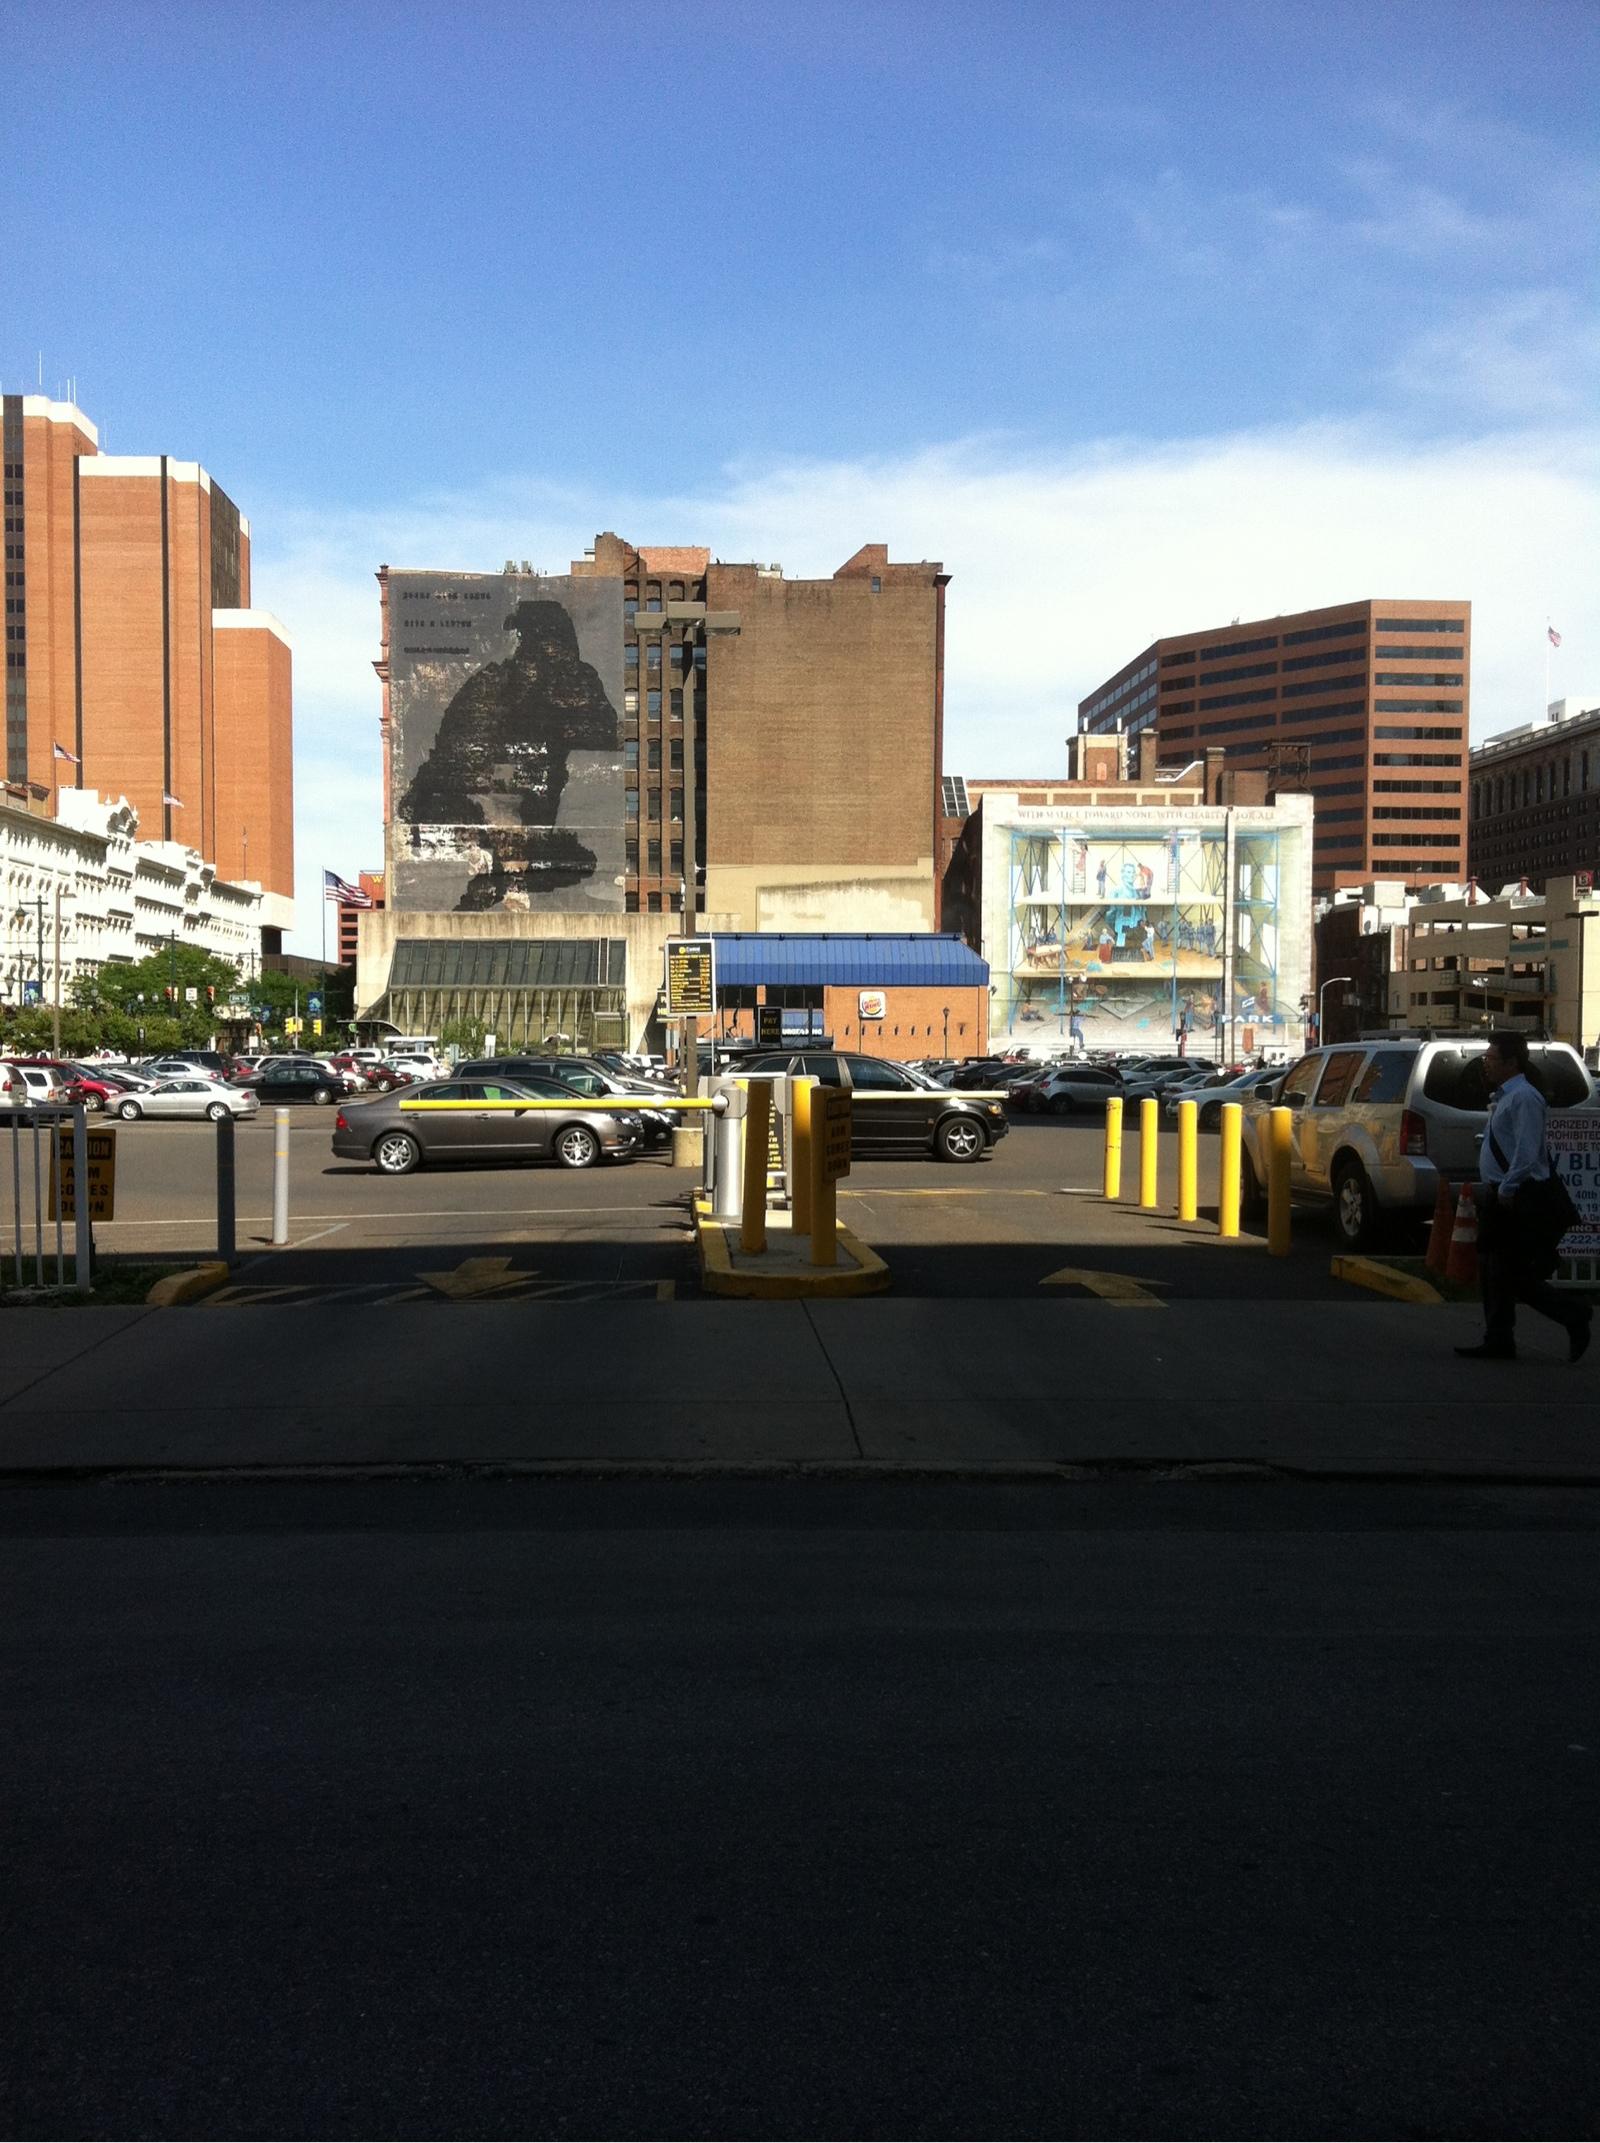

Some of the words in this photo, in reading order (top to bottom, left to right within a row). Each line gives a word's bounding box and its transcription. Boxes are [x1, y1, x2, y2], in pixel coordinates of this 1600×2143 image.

[1221, 1014, 1274, 1023] PARK
[1554, 1142, 1575, 1151] WILL
[1577, 1142, 1588, 1151] BE
[65, 1167, 100, 1178] AM
[60, 1184, 108, 1196] COES
